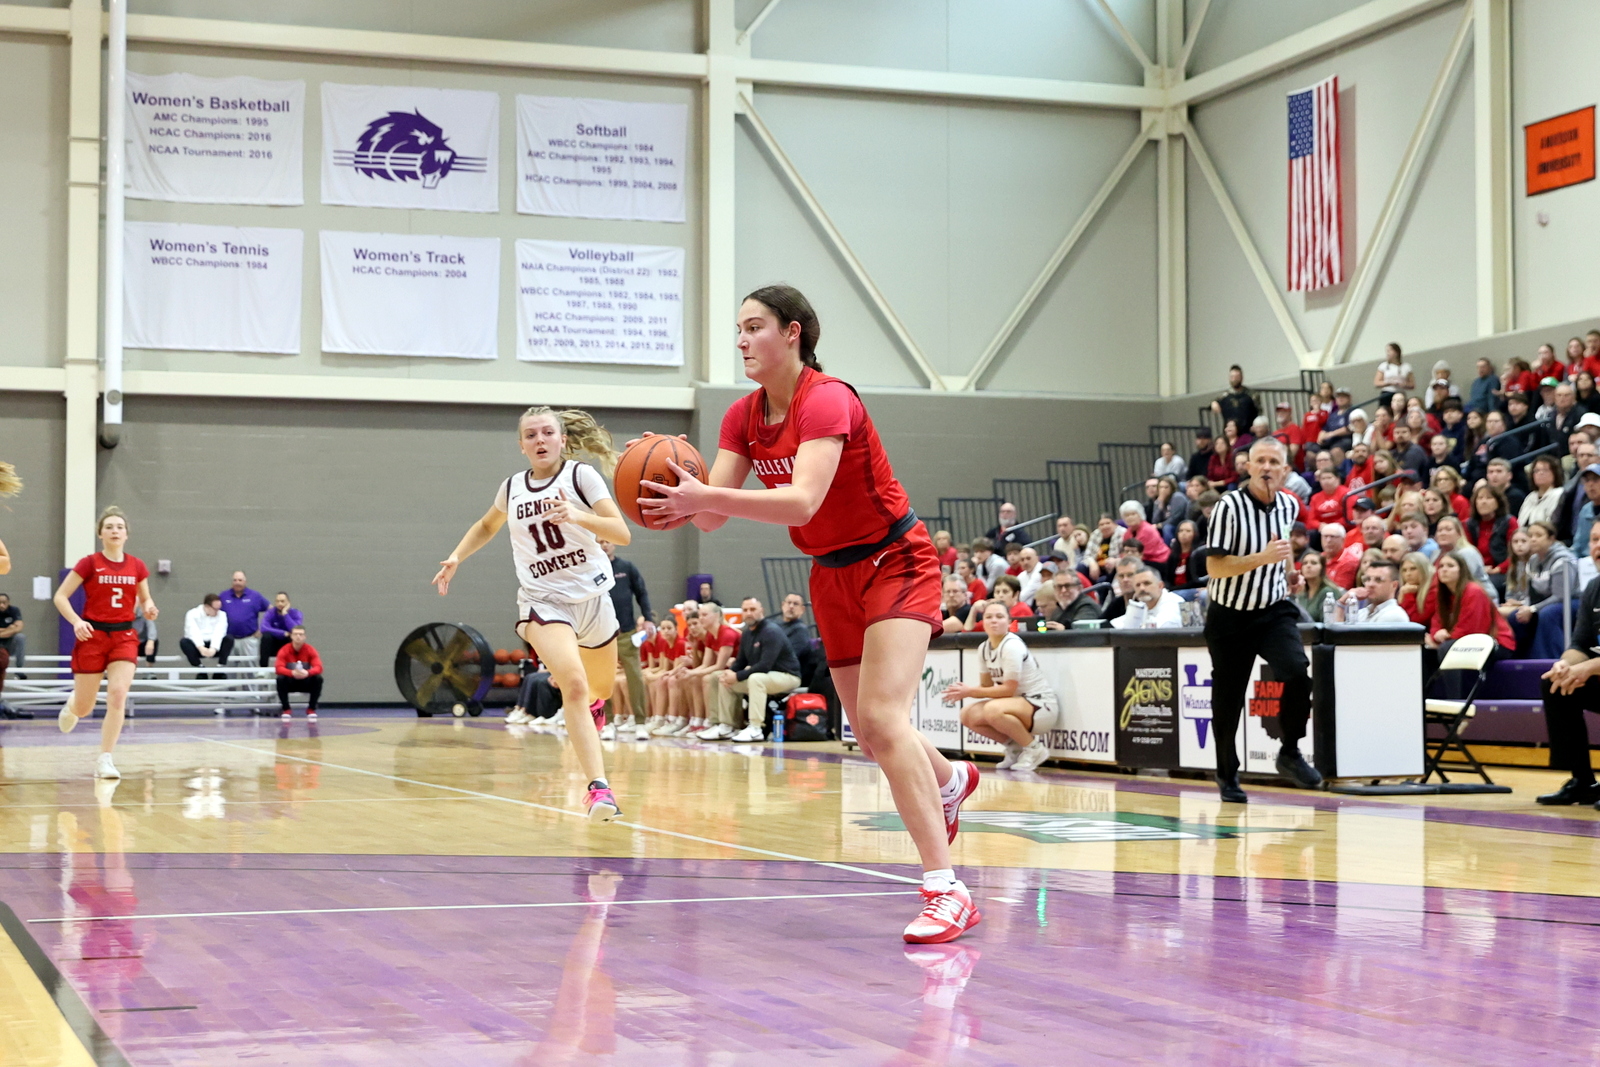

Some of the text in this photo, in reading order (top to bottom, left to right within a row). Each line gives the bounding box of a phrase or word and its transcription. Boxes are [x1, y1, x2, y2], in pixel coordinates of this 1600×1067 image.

[132, 91, 290, 112] Women's Basketball
[153, 112, 269, 127] AMC Champions: 1995
[149, 127, 272, 142] HCAC Champions: 2016
[576, 123, 627, 138] Softball
[148, 144, 273, 160] NCAA Tournament: 2016
[548, 139, 577, 149] WBCC
[579, 140, 632, 152] Champions:
[549, 151, 600, 162] Champions:
[552, 176, 604, 187] Champions:
[149, 238, 270, 257] Women's Tennis
[151, 256, 268, 270] WBCC Champions: 1984
[353, 248, 466, 265] Women's Track
[568, 248, 634, 264] Volleyball
[352, 265, 467, 278] HCAC Champions: 2004
[521, 262, 544, 271] NAIA
[546, 263, 596, 274] Champions
[599, 265, 635, 276] (District
[520, 286, 550, 296] WBCC
[552, 288, 605, 299] Champions:
[535, 312, 563, 321] HCAC
[565, 313, 617, 324] Champions:
[648, 316, 668, 325] 2011
[533, 325, 560, 334] NCAA
[562, 325, 617, 336] Tournament:
[528, 519, 566, 554] 10
[529, 548, 587, 579] COMETS
[98, 575, 136, 585] BELLEVUE
[111, 587, 123, 608] 2
[1253, 681, 1285, 698] FARM
[1120, 676, 1173, 731] SIGNS
[1249, 699, 1281, 717] EQUIP
